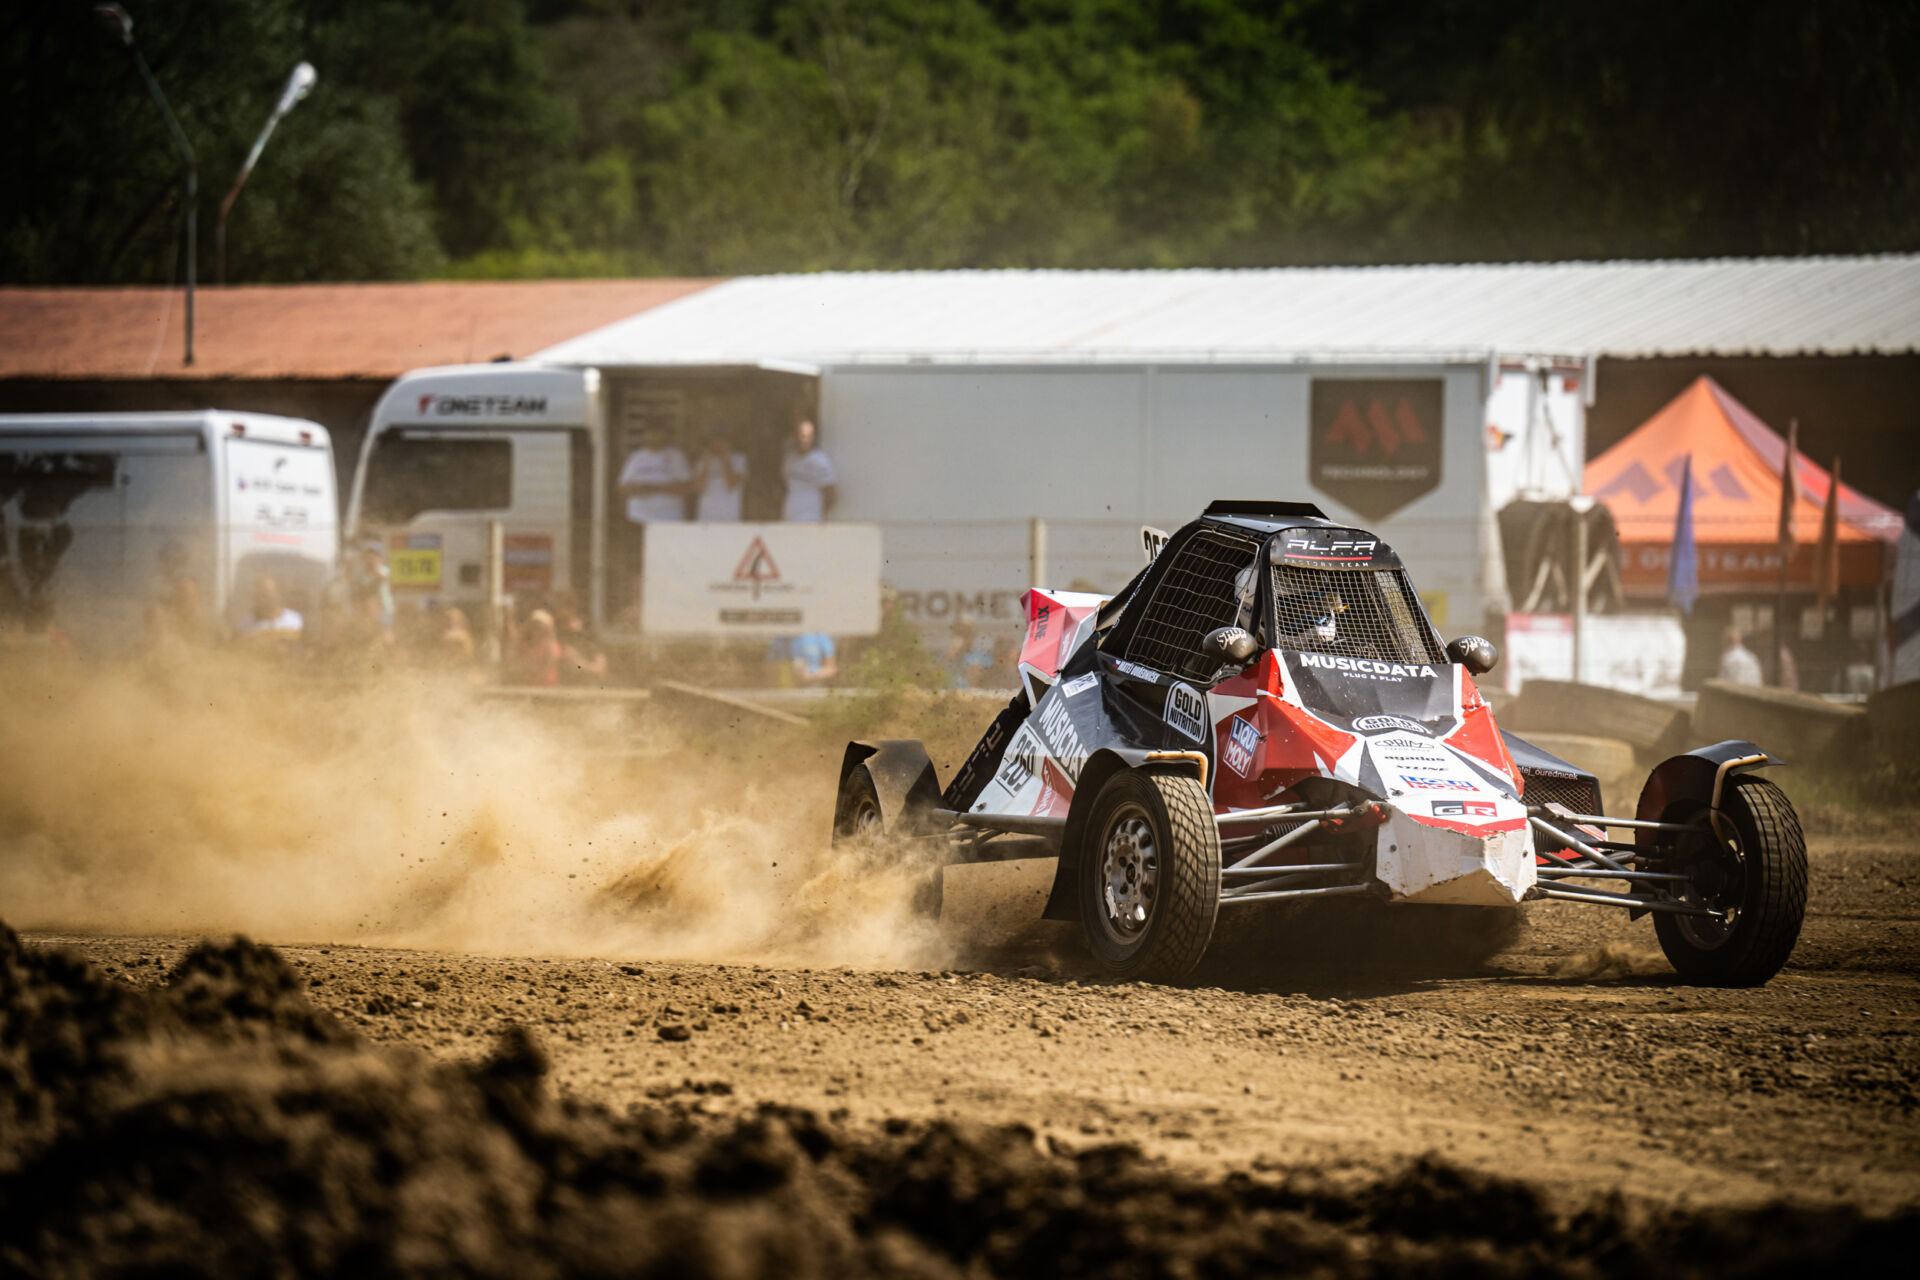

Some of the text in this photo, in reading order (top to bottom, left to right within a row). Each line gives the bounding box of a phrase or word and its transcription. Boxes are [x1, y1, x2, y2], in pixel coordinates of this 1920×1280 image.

[1287, 539, 1376, 551] ALFA
[1299, 653, 1439, 678] MUSICDATA
[1380, 675, 1403, 683] PLAY
[1174, 688, 1202, 720] GOLD
[1169, 707, 1202, 739] NUTRITION
[1364, 717, 1414, 728] GOLD
[1365, 723, 1422, 733] NUTRITION
[1232, 719, 1259, 753] LIQUI
[1225, 741, 1252, 773] MOLY
[1434, 805, 1496, 817] GR
